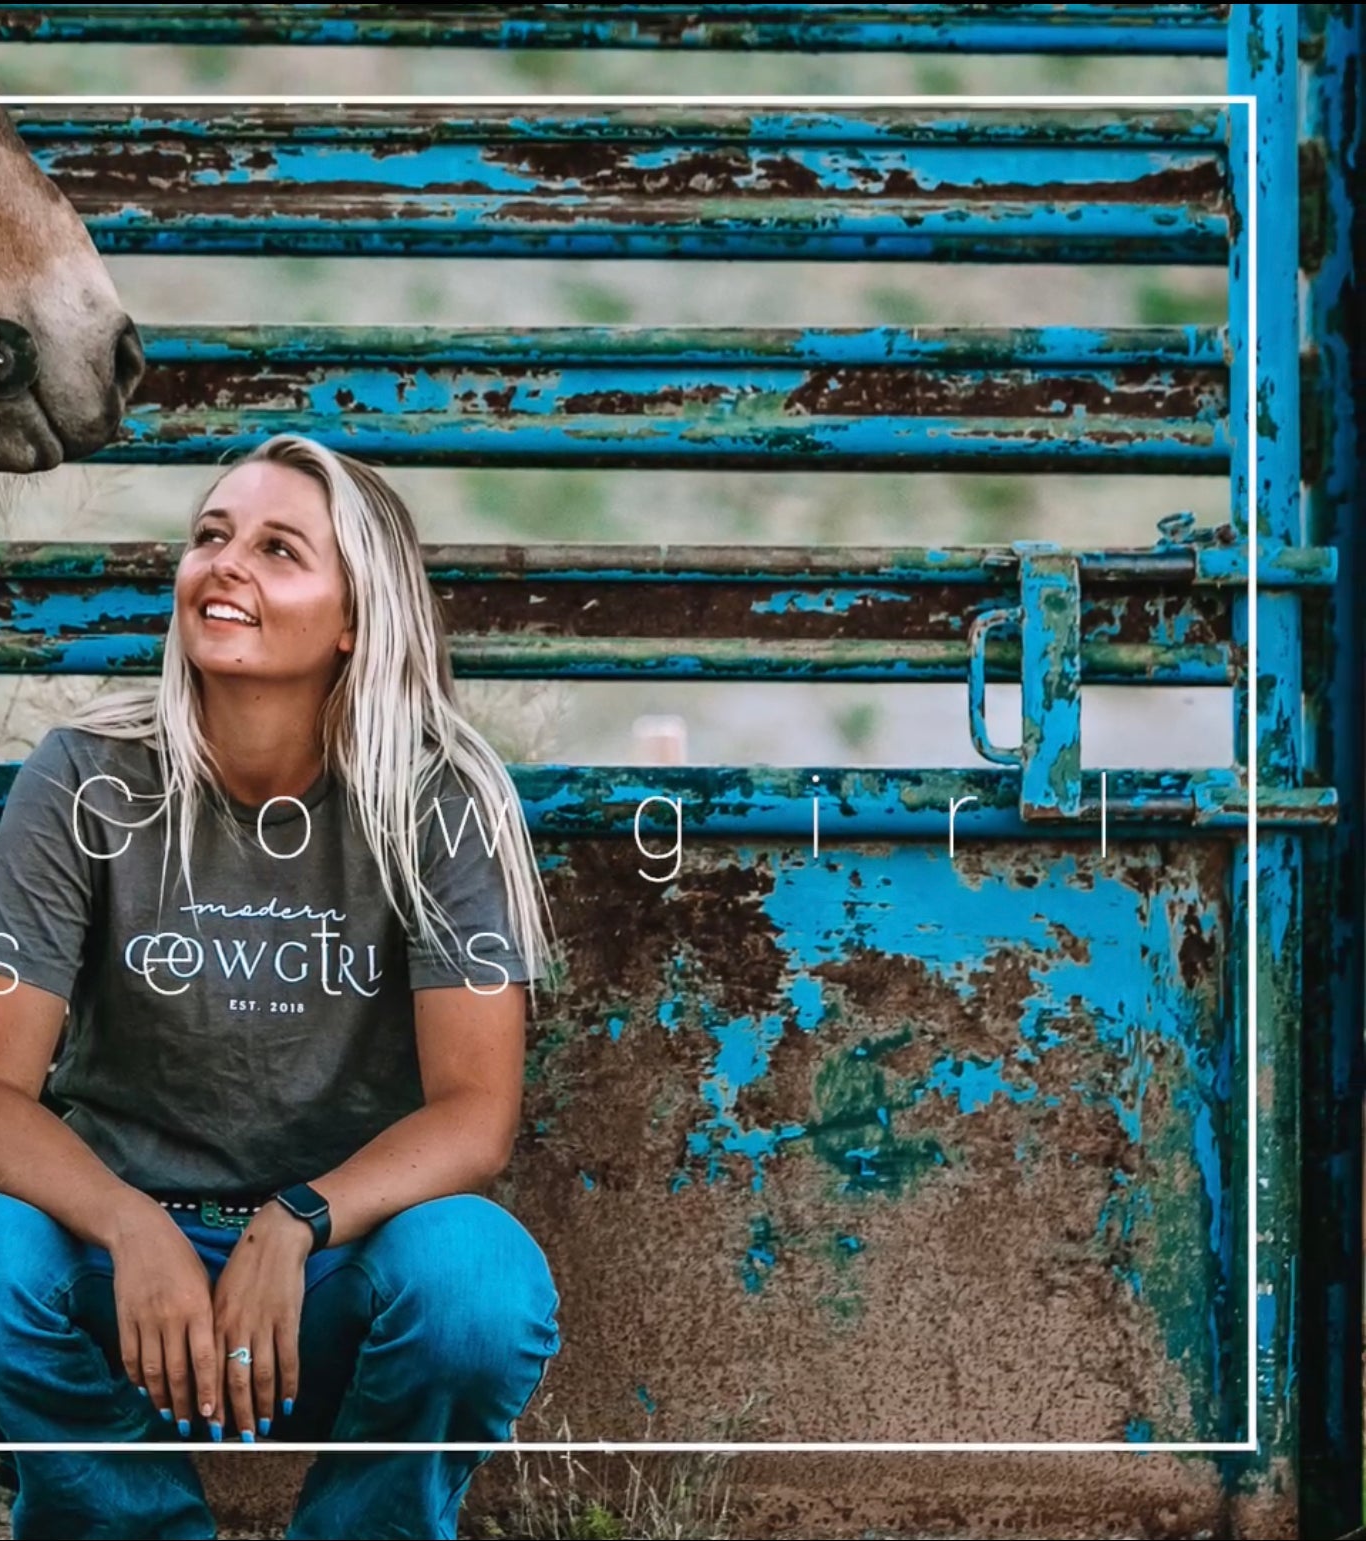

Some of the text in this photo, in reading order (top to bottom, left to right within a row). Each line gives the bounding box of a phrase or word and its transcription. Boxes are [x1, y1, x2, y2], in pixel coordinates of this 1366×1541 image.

[180, 897, 347, 922] modern
[229, 999, 305, 1013] EST. 2018
